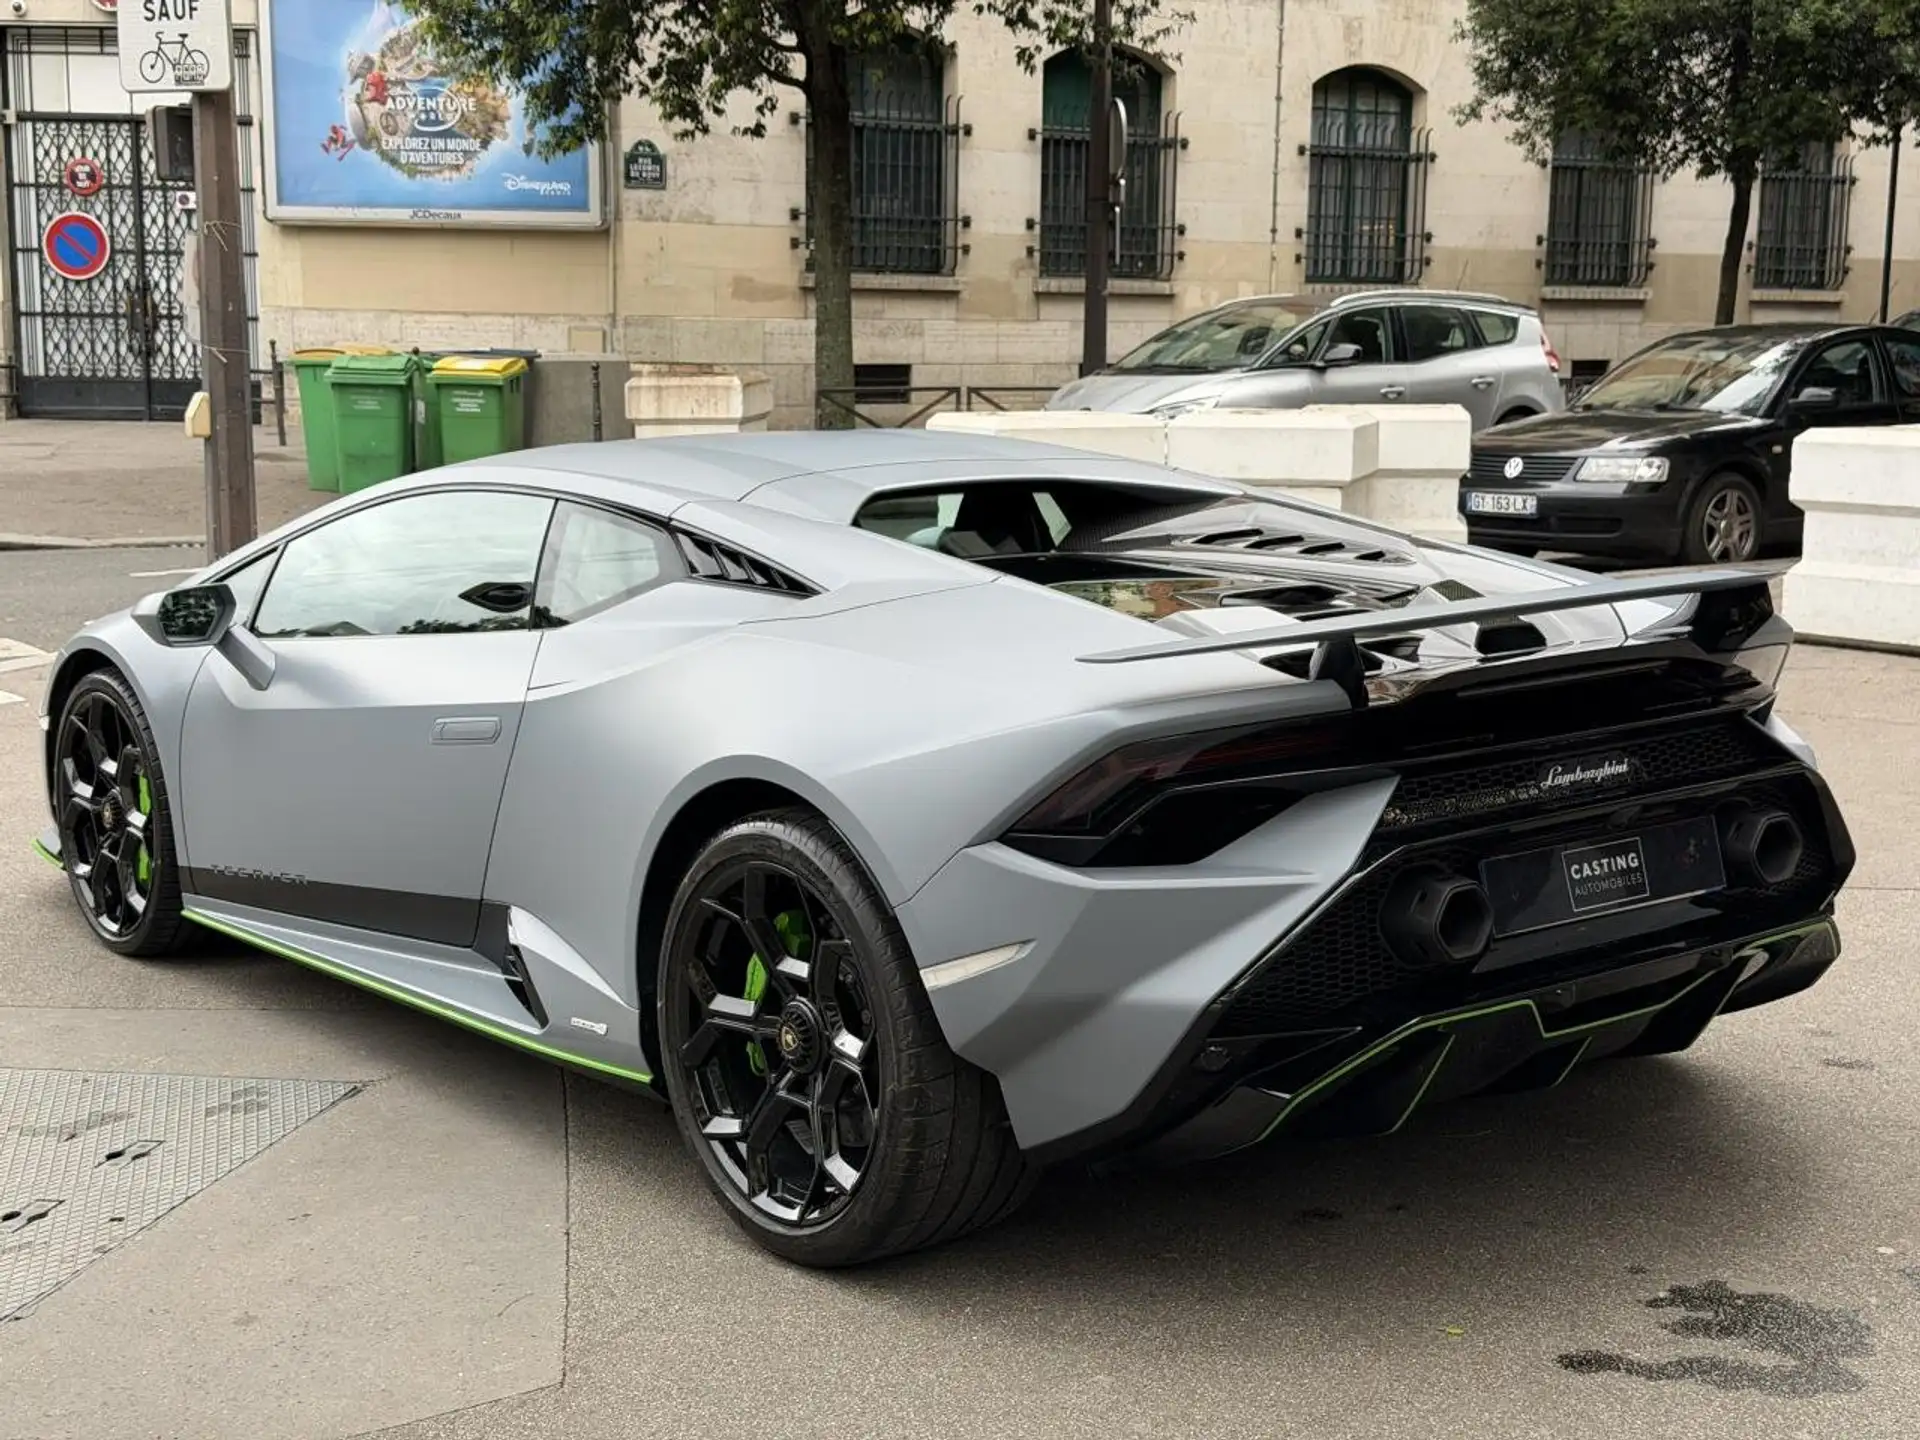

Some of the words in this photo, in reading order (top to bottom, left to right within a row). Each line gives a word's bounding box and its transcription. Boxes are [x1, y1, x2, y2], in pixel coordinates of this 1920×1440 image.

[143, 0, 199, 21] SAUF
[386, 97, 477, 111] ADVENTURE
[381, 137, 430, 150] EXPLOREZ
[431, 138, 446, 150] UN
[447, 138, 481, 151] MONDE
[400, 151, 465, 165] D'AVENTURES
[410, 210, 462, 220] JCDecaux
[1540, 758, 1629, 789] Lamborghini
[1571, 852, 1640, 880] CASTING
[1574, 872, 1643, 898] AUTOMOBILES
